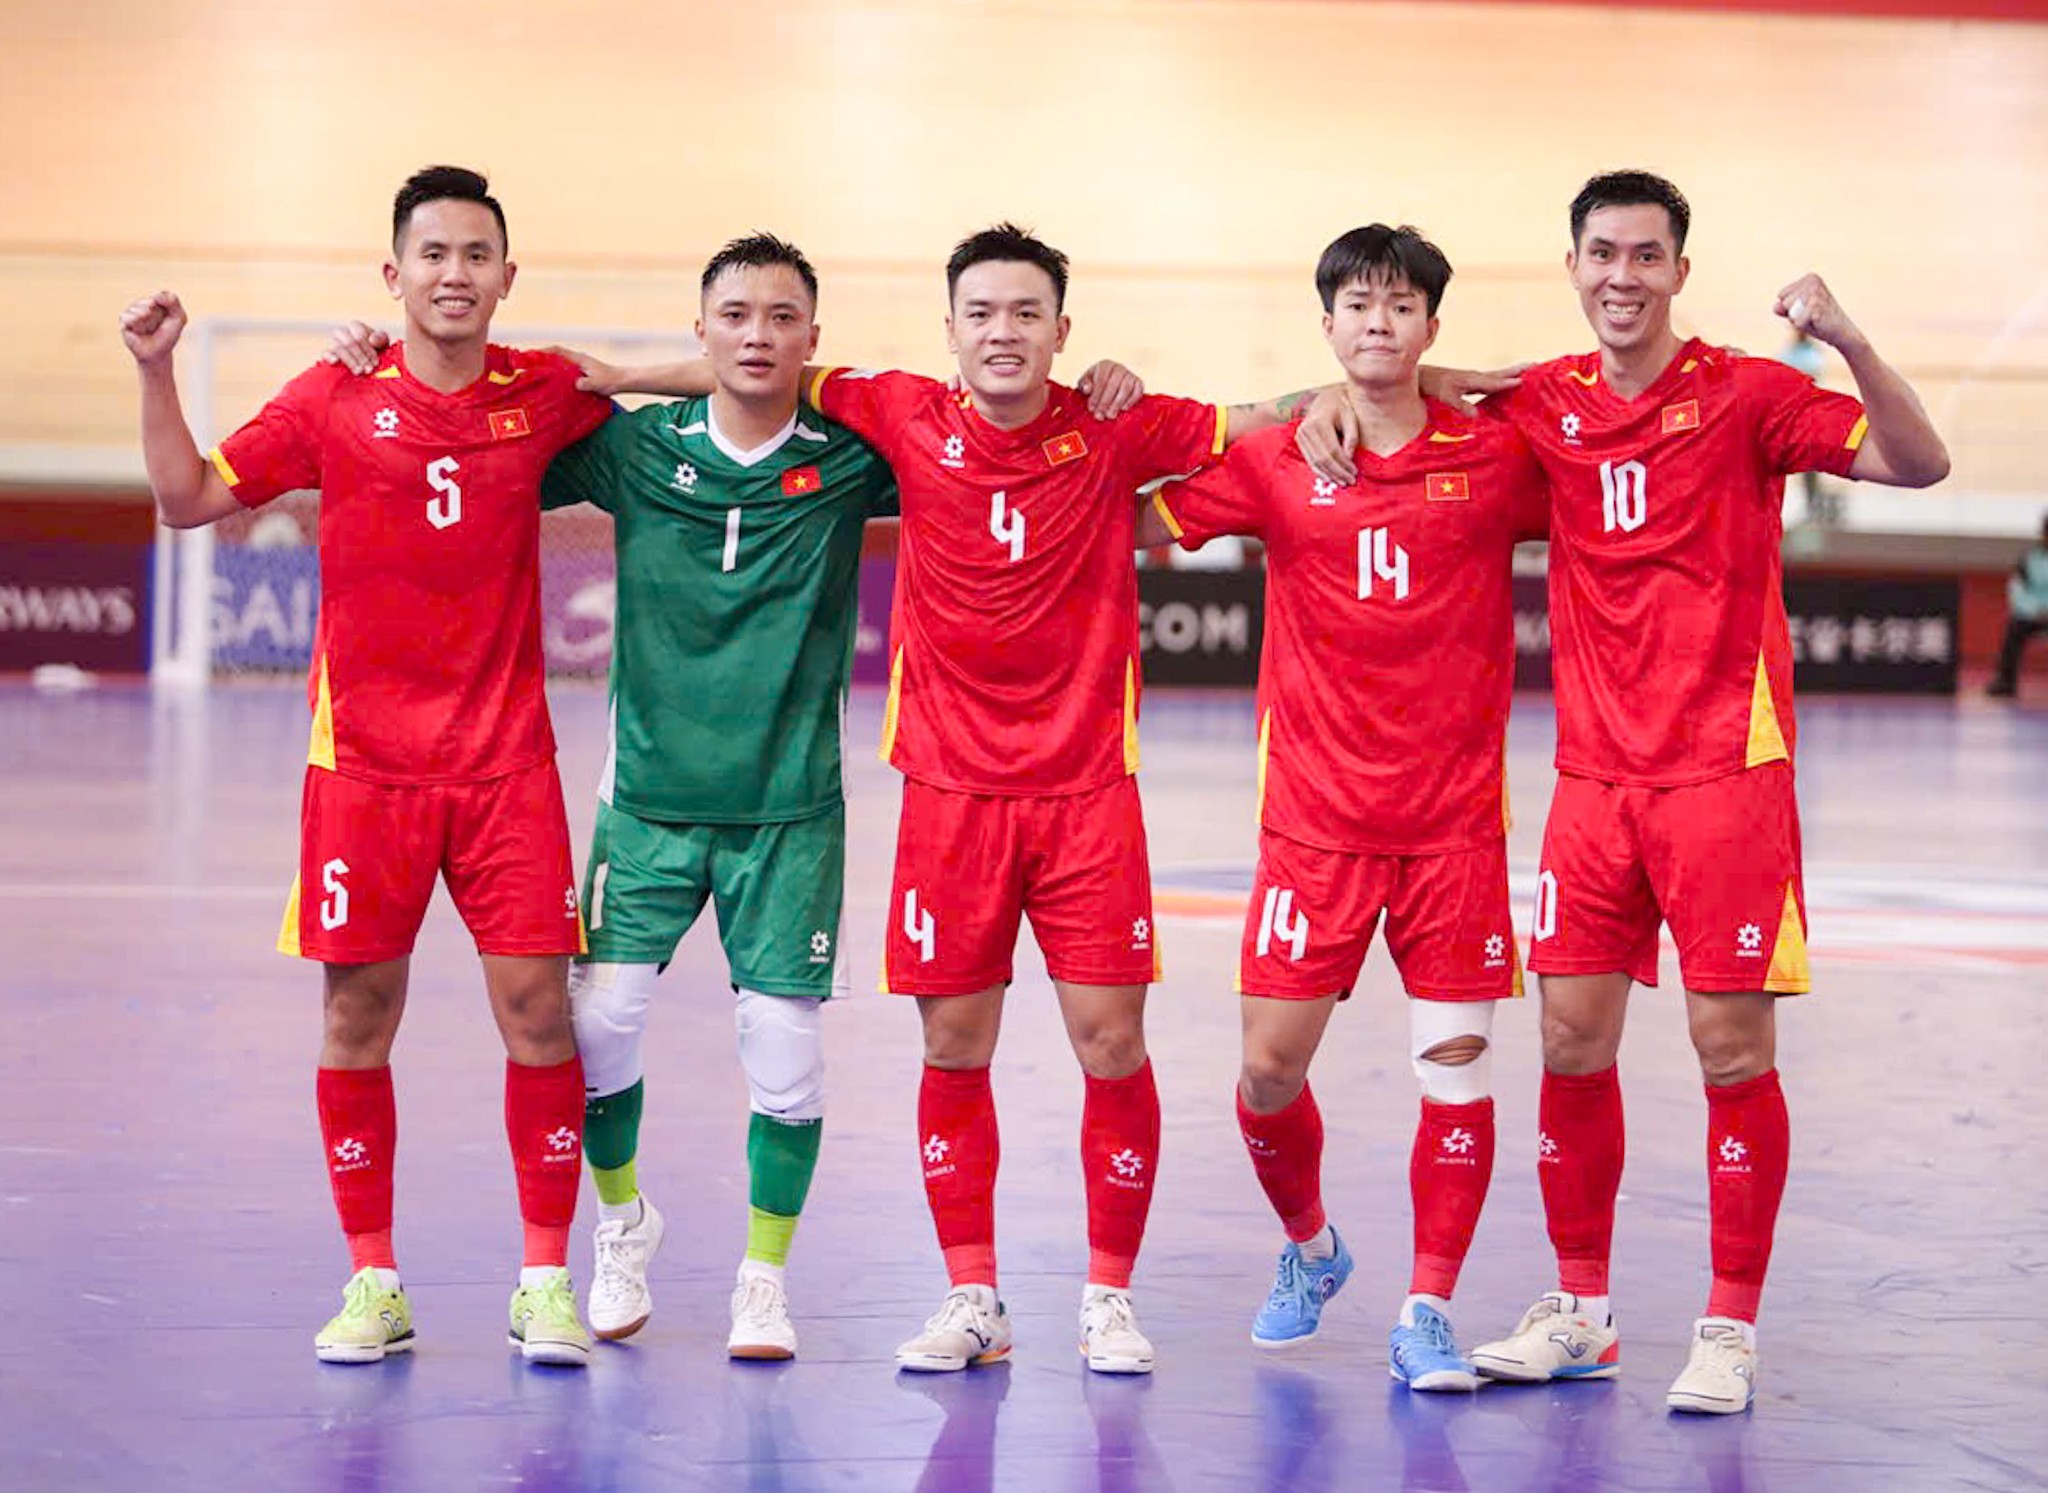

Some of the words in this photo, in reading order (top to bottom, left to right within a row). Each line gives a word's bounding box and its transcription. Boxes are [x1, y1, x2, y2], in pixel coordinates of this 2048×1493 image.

[990, 491, 1025, 562] 4
[1599, 461, 1646, 532] 10
[722, 507, 742, 573] 1
[1358, 527, 1409, 600] 14
[590, 861, 610, 931] 1
[904, 888, 936, 963] 4
[1256, 886, 1309, 961] 14
